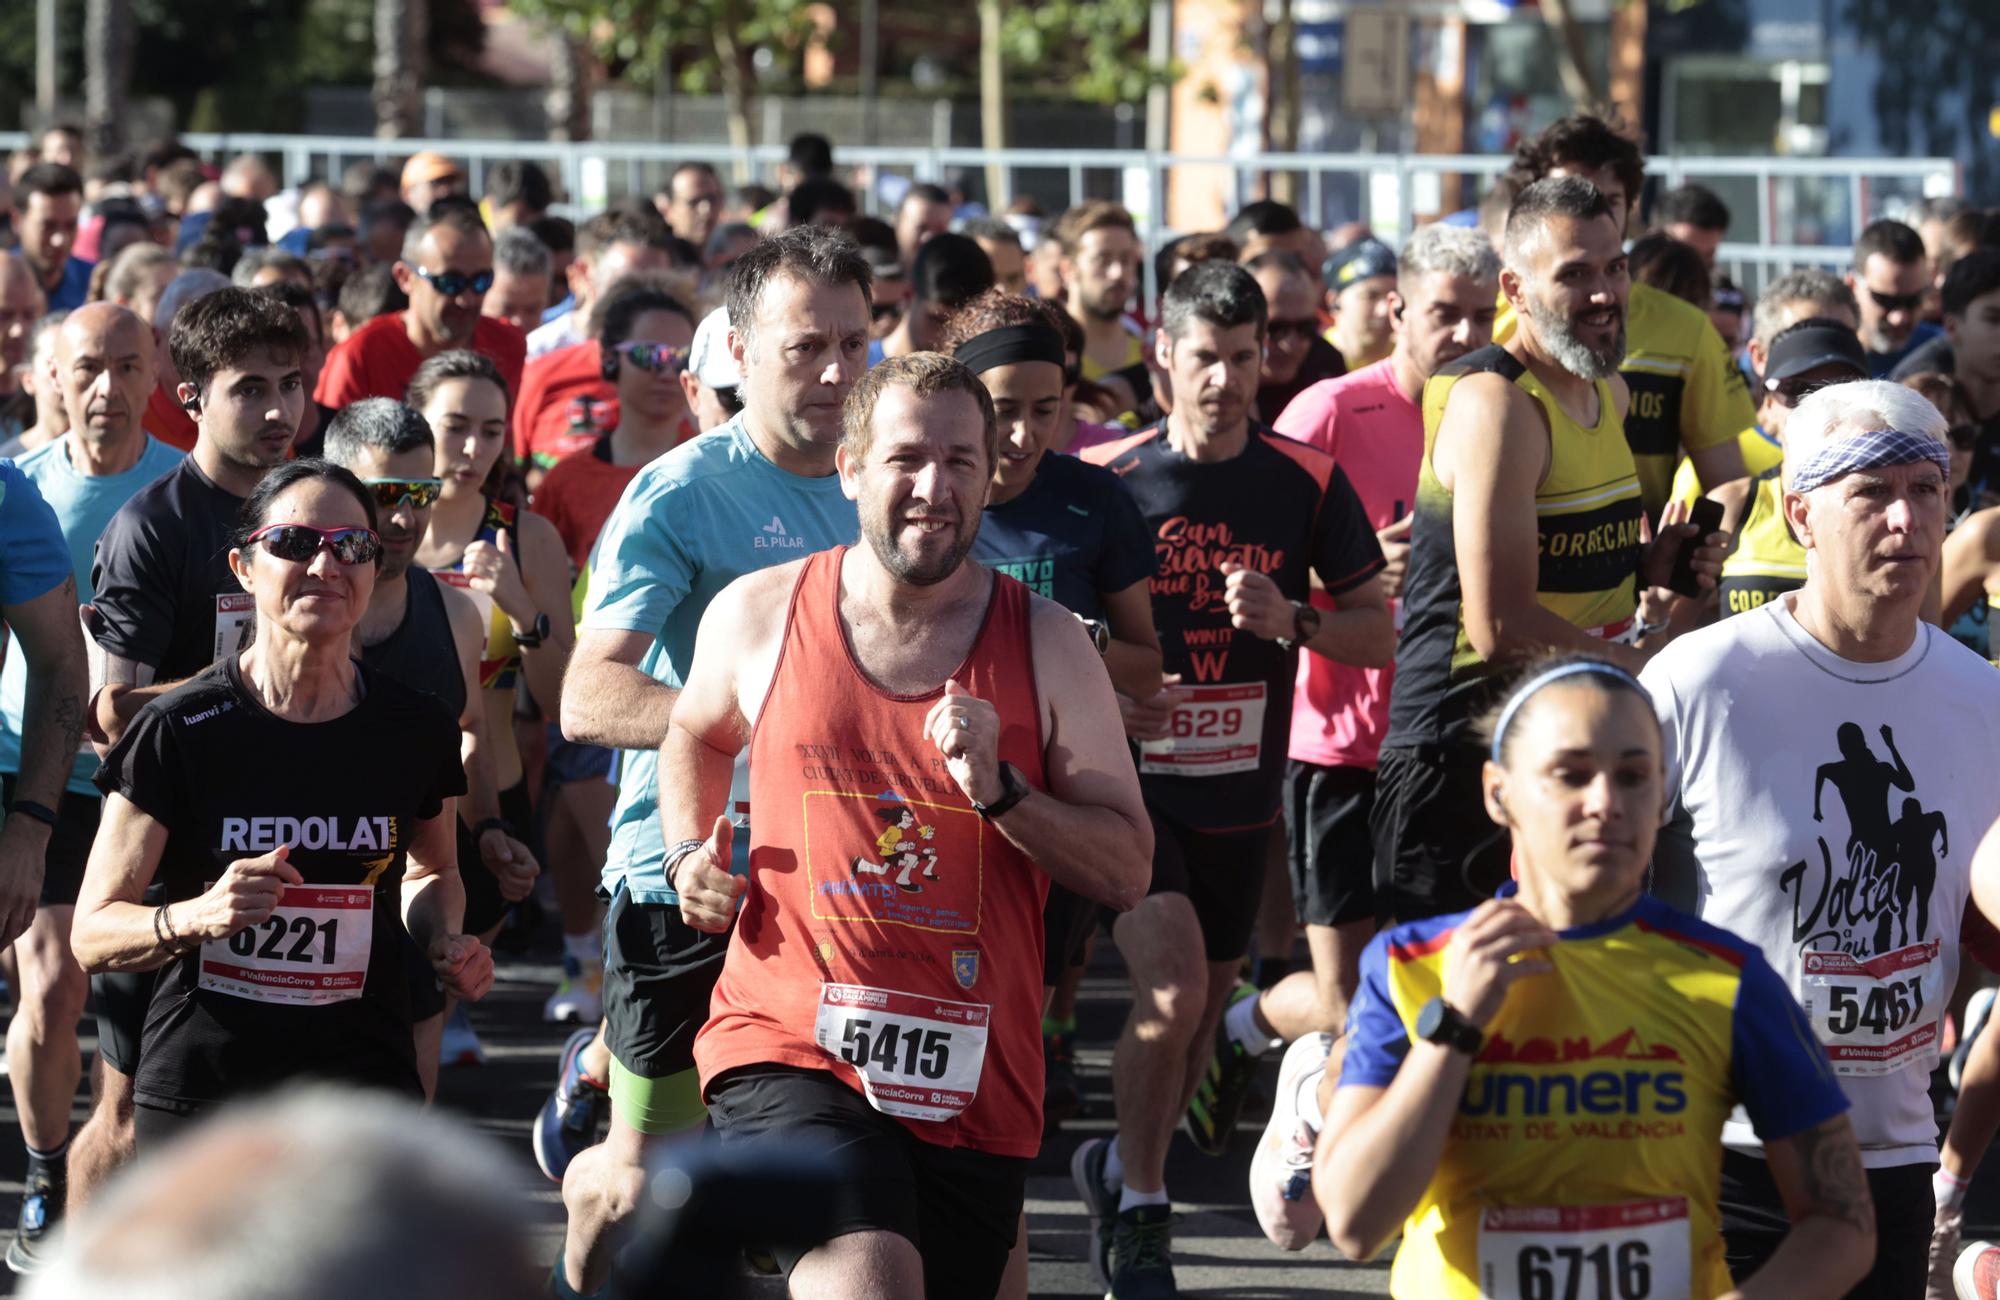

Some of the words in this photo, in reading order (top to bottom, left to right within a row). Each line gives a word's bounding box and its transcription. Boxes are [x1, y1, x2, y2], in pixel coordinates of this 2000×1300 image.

[754, 536, 769, 548] EL
[770, 536, 805, 548] PILAR
[1158, 515, 1232, 549] San
[1183, 628, 1216, 645] WIN
[1218, 627, 1233, 643] IT
[183, 704, 220, 726] luanvi
[1171, 708, 1243, 737] 629
[851, 749, 901, 765] VOLTA
[910, 756, 924, 770] A
[803, 766, 854, 783] CIUTAT
[859, 770, 881, 785] DE
[221, 816, 390, 852] REDOLAT
[389, 816, 398, 849] TEAM
[1779, 836, 1902, 943] Volta
[229, 914, 338, 965] 6221
[1843, 929, 1853, 939] a
[240, 969, 316, 987] #ValènciaCorre
[841, 1018, 952, 1080] 5415
[1525, 1120, 1561, 1141] DE
[1517, 1239, 1652, 1300] 6716
